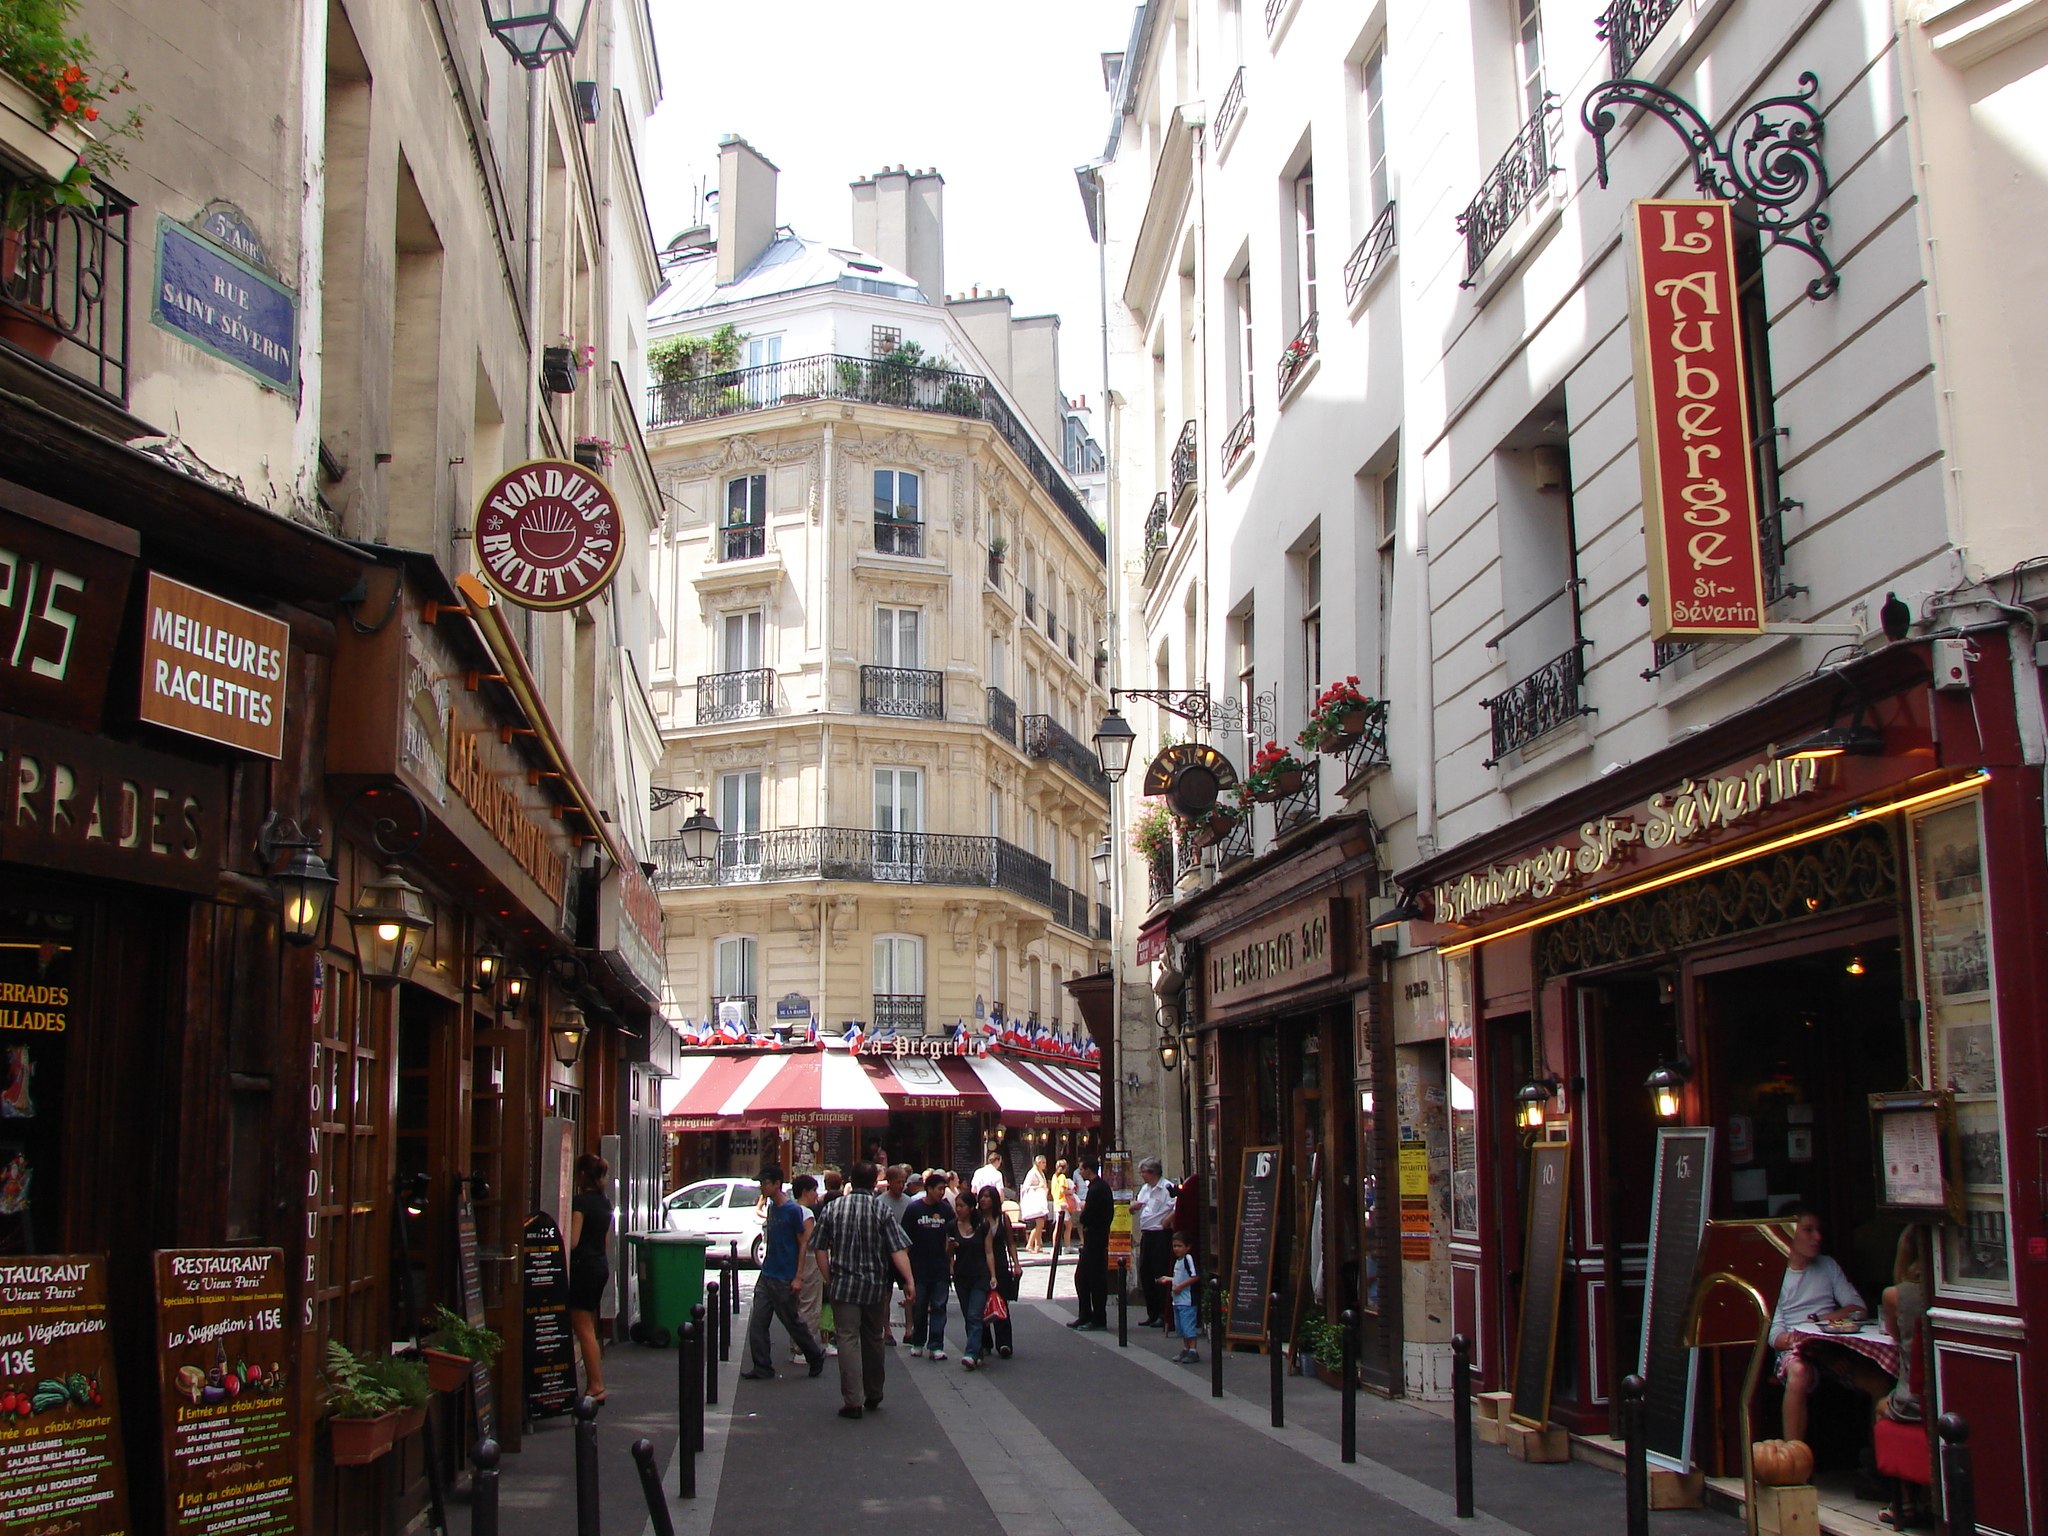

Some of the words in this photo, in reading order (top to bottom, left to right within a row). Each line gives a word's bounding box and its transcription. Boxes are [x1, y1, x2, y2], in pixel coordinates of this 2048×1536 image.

[213, 274, 249, 310] RUE
[163, 283, 215, 325] SAINT
[221, 315, 290, 367] SÉVERIN
[1654, 210, 1733, 570] L'Auberge
[490, 469, 611, 521] FONDUES
[482, 532, 613, 597] RACLETTES
[1672, 599, 1757, 624] Séverin
[152, 606, 281, 682] MEILLEURES
[155, 659, 273, 727] RACLETTES
[0, 752, 203, 861] RRADES
[1432, 845, 1571, 924] L'Auberge
[1643, 743, 1818, 850] Séverin
[1213, 957, 1229, 994] LE
[1232, 930, 1295, 988] BISTROT
[858, 1037, 882, 1056] La
[902, 1095, 918, 1107] La
[920, 1095, 965, 1109] Prégrille
[807, 1111, 854, 1124] Françaises
[304, 1041, 321, 1326] FONDUES
[1401, 1214, 1430, 1223] CHOPIN
[172, 1254, 272, 1276] RESTAURANT
[2, 1286, 41, 1302] Vieux
[202, 1277, 232, 1290] Vieux
[28, 1319, 107, 1345] Végétarien
[168, 1332, 184, 1349] La
[187, 1318, 247, 1345] Suggestion
[248, 1315, 254, 1331] à
[257, 1308, 282, 1331] 15€
[1, 1349, 36, 1376] 13€
[25, 1427, 40, 1437] au
[44, 1416, 112, 1435] choix/Starter
[177, 1406, 184, 1422] 1
[186, 1406, 213, 1419] Entrée
[216, 1405, 228, 1415] au
[177, 1423, 198, 1433] AVOCAT
[187, 1432, 211, 1443] SALADE
[7, 1444, 26, 1455] AUX
[28, 1438, 63, 1452] LÉGUMES
[7, 1455, 41, 1469] SALADE
[42, 1447, 87, 1463] MÉLI-MÉLO
[174, 1446, 195, 1457] SALADE
[195, 1445, 204, 1453] AU
[188, 1455, 212, 1466] SALADE
[0, 1486, 34, 1501] SALADE
[35, 1483, 48, 1494] AU
[50, 1473, 98, 1490] ROQUEFORT
[178, 1492, 184, 1509] 1
[186, 1492, 203, 1505] Plat
[207, 1491, 218, 1501] au
[268, 1475, 293, 1488] course
[16, 1501, 54, 1517] TOMATES
[55, 1499, 66, 1509] ET
[66, 1490, 115, 1508] CONCOMBRES
[201, 1504, 212, 1514] AU
[212, 1499, 235, 1512] POIVRE
[235, 1497, 245, 1506] OU
[245, 1495, 255, 1504] AU
[255, 1487, 289, 1502] ROQUEFORT
[207, 1518, 237, 1532] ESCALOPE
[237, 1510, 271, 1525] NORMANDE
